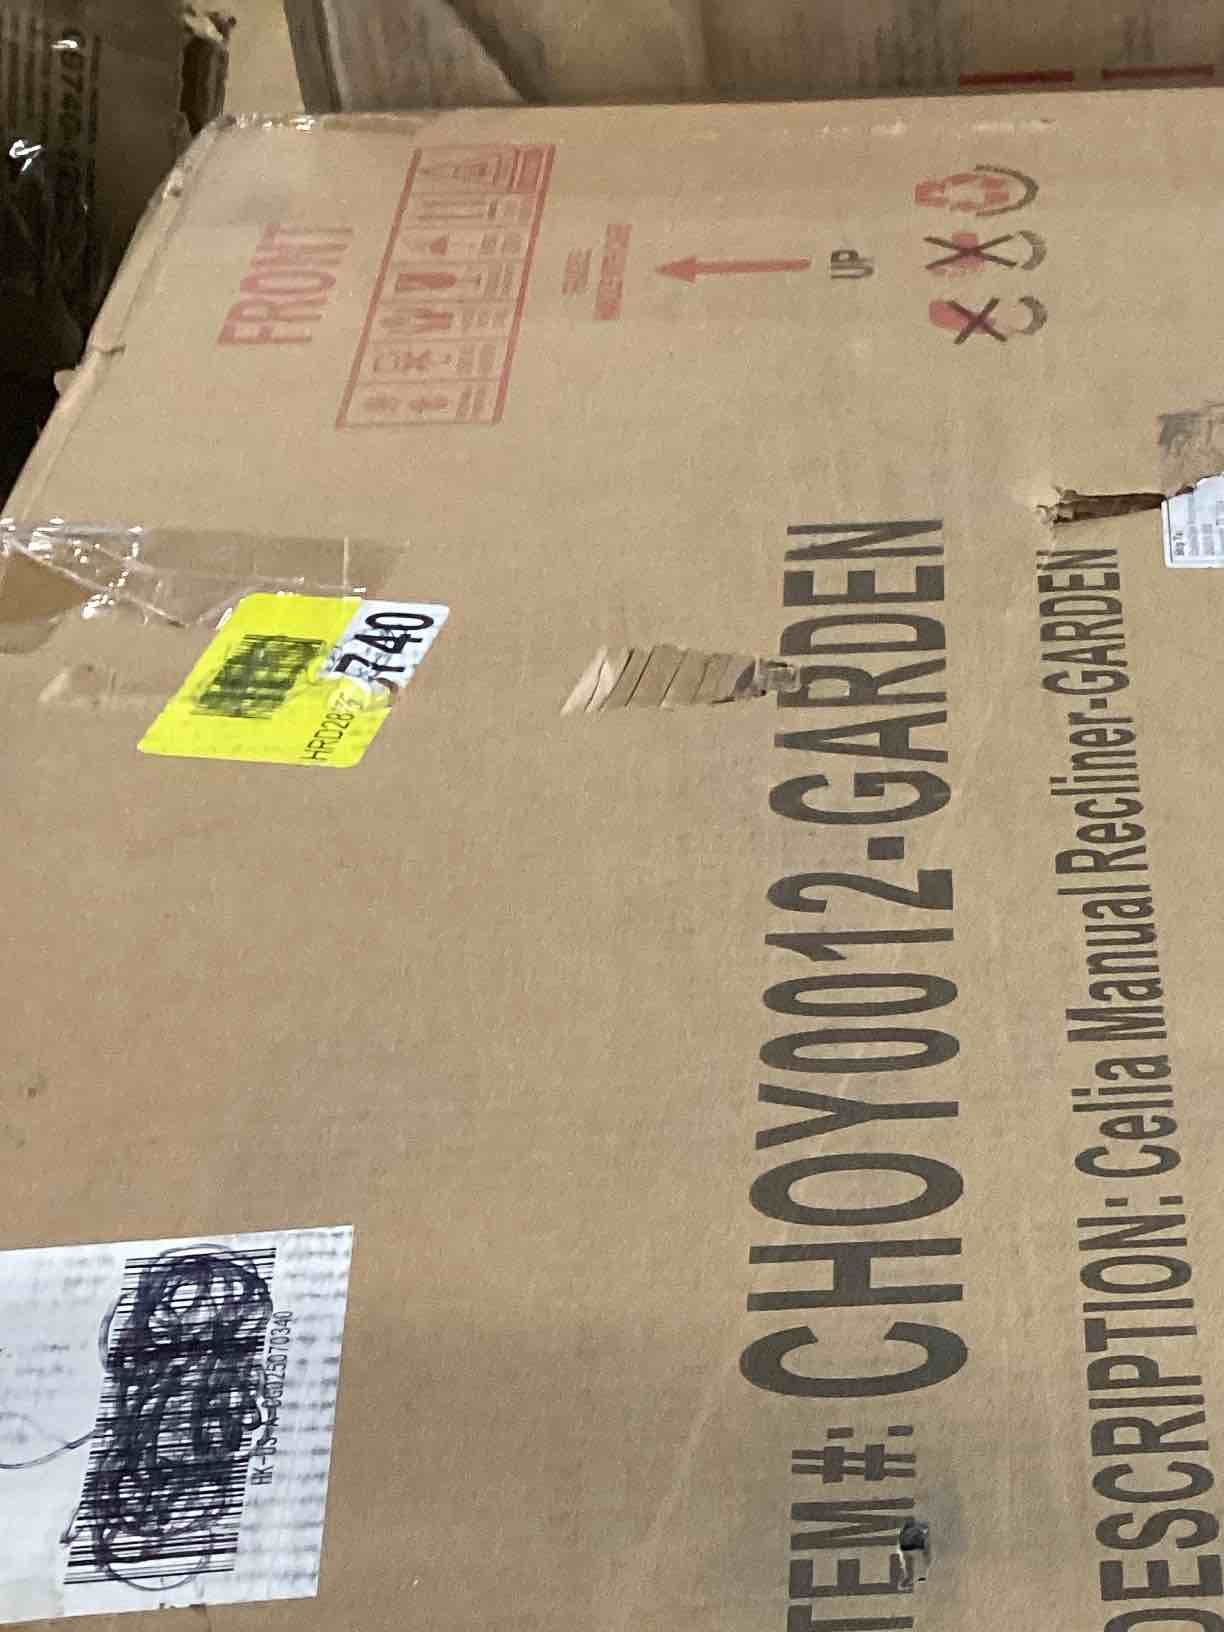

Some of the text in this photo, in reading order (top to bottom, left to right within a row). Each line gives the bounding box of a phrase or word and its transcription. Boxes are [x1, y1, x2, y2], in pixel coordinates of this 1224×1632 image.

[218, 223, 353, 345] FRONT
[830, 248, 874, 280] UP
[1036, 548, 1150, 874] Recliner-GARDEN
[739, 519, 969, 1399] CHOY0012-GARDEN
[1057, 884, 1168, 1043] Manual
[1071, 1054, 1182, 1178] Celia
